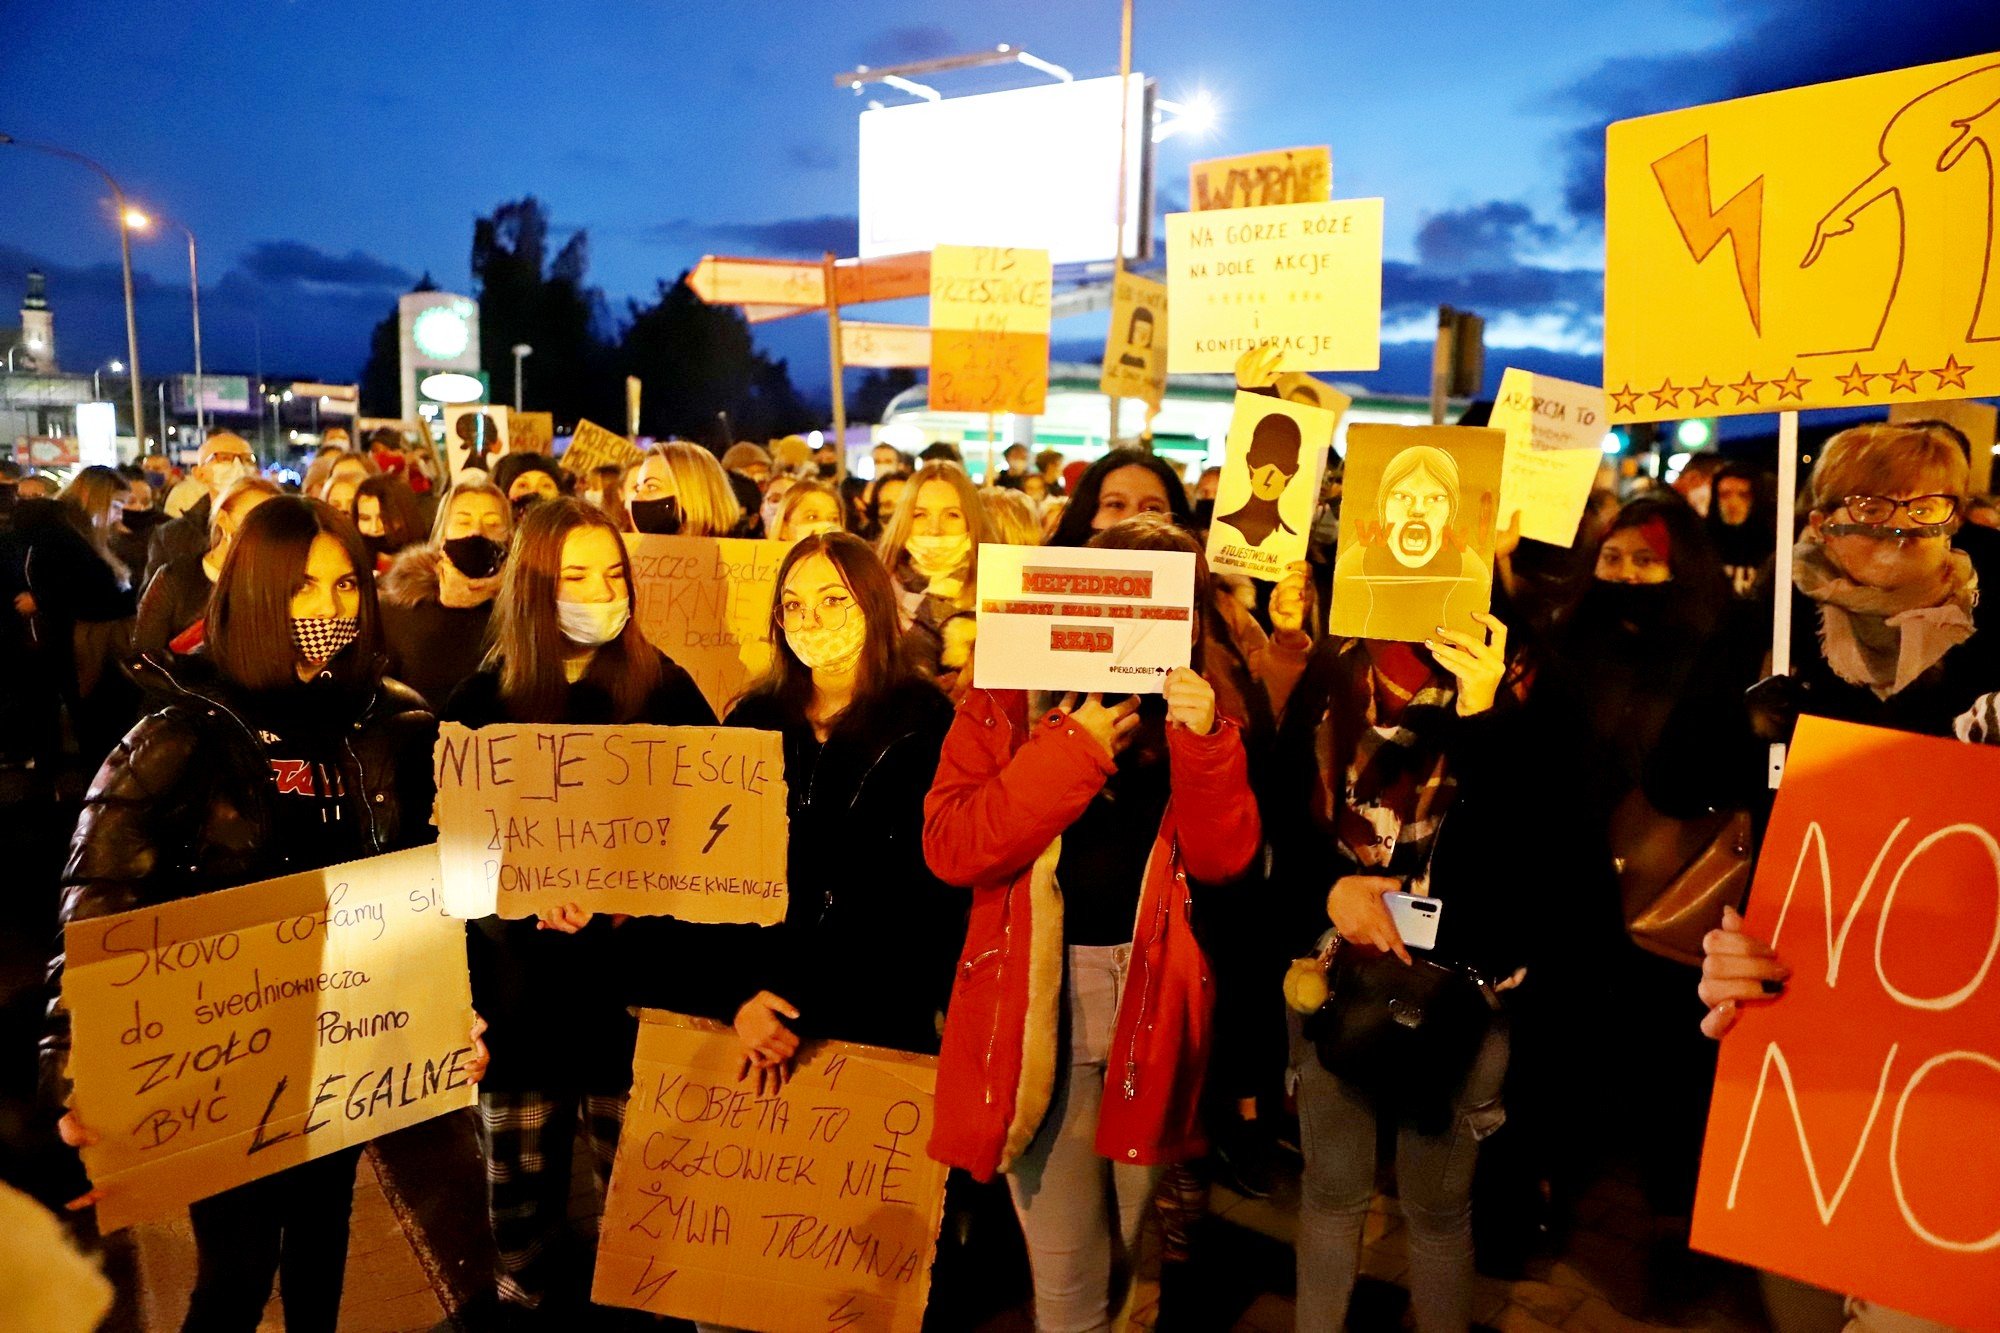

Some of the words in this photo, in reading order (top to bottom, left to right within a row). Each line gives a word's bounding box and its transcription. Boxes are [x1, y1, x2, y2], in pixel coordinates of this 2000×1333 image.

[974, 246, 1015, 271] PIS
[1191, 227, 1213, 247] NA
[1191, 265, 1207, 278] NA
[1217, 259, 1254, 275] DOLE
[1275, 254, 1330, 274] AKCJE
[1502, 392, 1566, 420] ABORCJA
[1577, 406, 1596, 425] TO
[1220, 545, 1278, 564] #TOJESTWOJNA
[1022, 572, 1152, 597] MEFEDRON
[1051, 631, 1113, 652] RZĄD
[439, 734, 519, 791] NIE
[485, 808, 545, 853] JAK
[276, 882, 386, 944] cofamy
[1771, 816, 2000, 1012] NO
[120, 1000, 164, 1046] do
[128, 1027, 272, 1097] ZIOŁO
[132, 1077, 229, 1152] BYĆ
[246, 1046, 473, 1156] LEGALNE
[653, 1072, 790, 1136] KOBIETA
[809, 1106, 851, 1143] TO
[643, 1131, 817, 1186] CZŁOWIEK
[839, 1156, 921, 1207] NIE
[1726, 1041, 2000, 1253] NO
[629, 1180, 731, 1247] ŻYWA
[761, 1212, 919, 1283] TRUMNA
